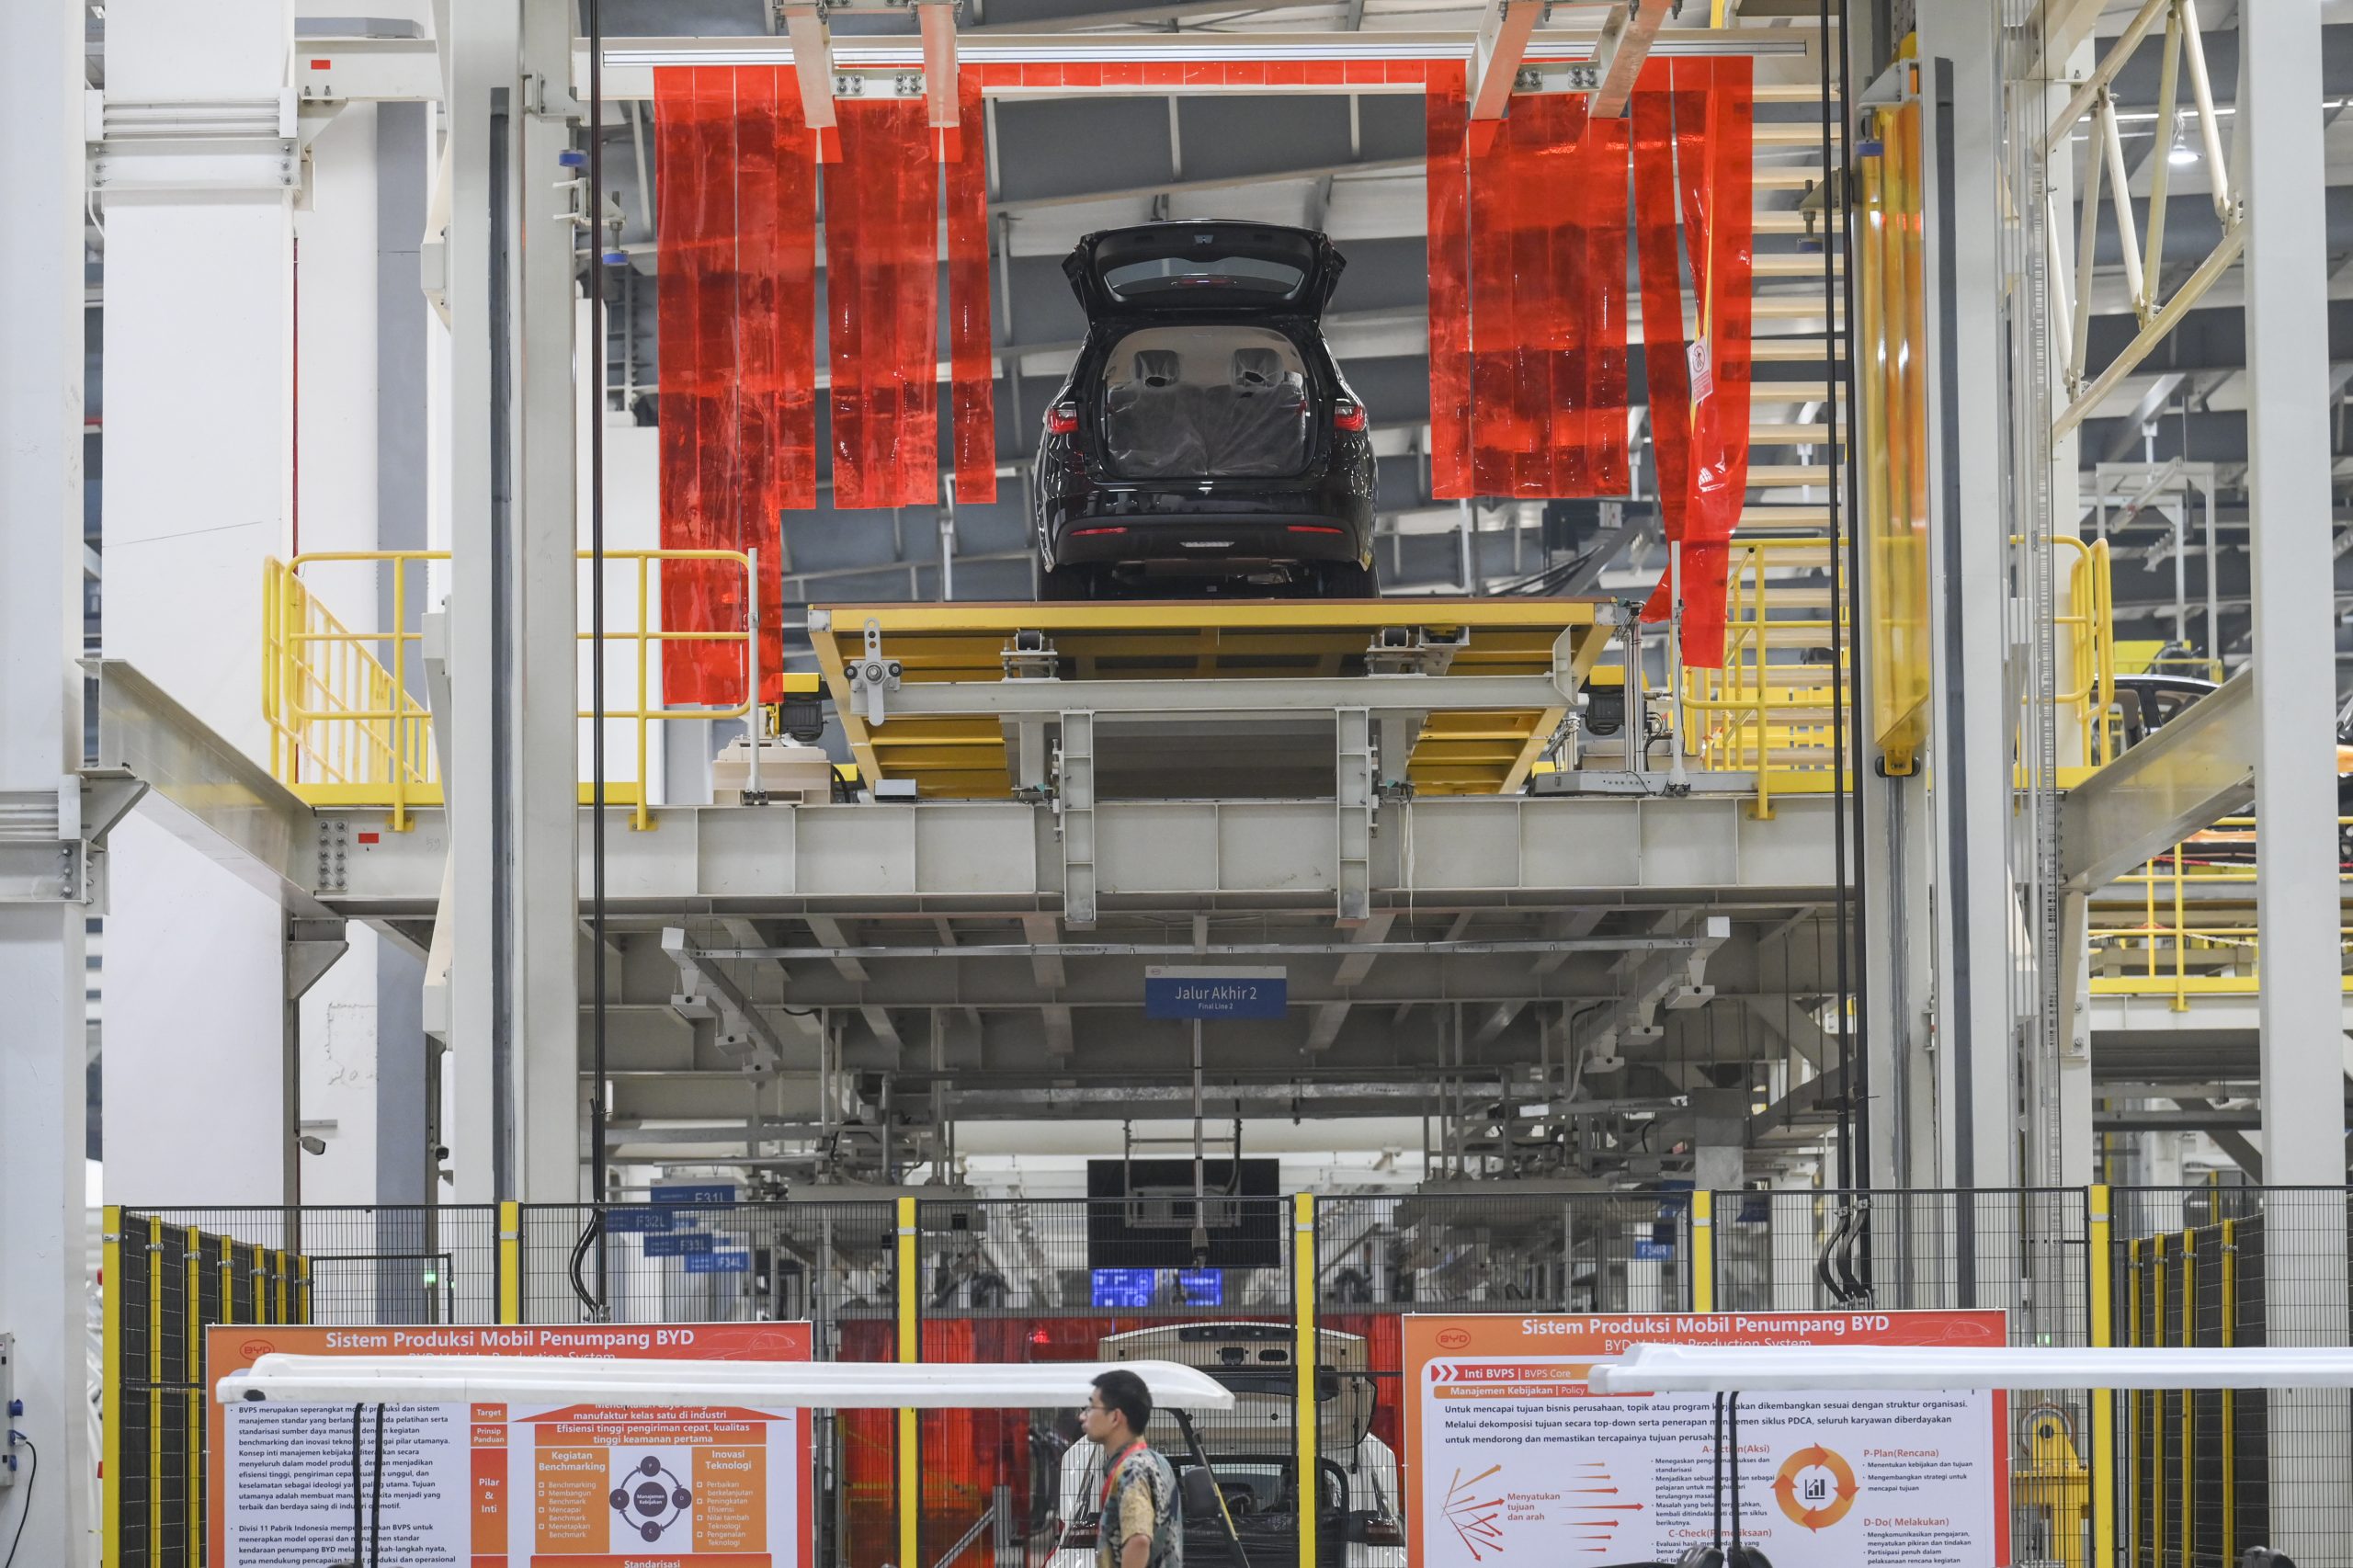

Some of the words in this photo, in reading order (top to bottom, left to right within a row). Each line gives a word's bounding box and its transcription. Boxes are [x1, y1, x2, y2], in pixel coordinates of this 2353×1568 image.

[1176, 986, 1210, 999] Jalur
[1212, 986, 1247, 999] Akhir
[1250, 987, 1256, 999] 2
[1522, 1320, 1583, 1335] Sistem
[1591, 1319, 1669, 1333] Produksi
[1677, 1317, 1729, 1333] Mobil
[1736, 1317, 1845, 1335] Penumpang
[1852, 1316, 1889, 1331] BYD
[326, 1332, 387, 1347] Sistem
[394, 1332, 473, 1347] Produksi
[482, 1331, 533, 1346] Mobil
[540, 1331, 650, 1349] Penumpang
[656, 1330, 694, 1345] BYD
[1440, 1335, 1466, 1343] BYD
[1605, 1340, 1631, 1352] BYD
[1465, 1368, 1483, 1379] Inti
[1486, 1369, 1514, 1378] BVPS
[1525, 1369, 1548, 1378] BVPS
[1551, 1369, 1571, 1378] Core
[1450, 1387, 1505, 1397] Manajemen
[1508, 1386, 1552, 1396] Kebijakan
[1562, 1387, 1585, 1395] Policy
[1473, 1404, 1514, 1415] mencapai
[1517, 1404, 1543, 1414] tujuan
[1574, 1404, 1624, 1414] perusahaan,
[1627, 1403, 1648, 1414] topik
[1673, 1404, 1710, 1413] program
[1758, 1402, 1820, 1411] dikembangkan
[1824, 1401, 1849, 1409] sesuai
[1852, 1401, 1883, 1411] dengan
[1923, 1400, 1967, 1410] organisasi.
[477, 1409, 501, 1418] Target
[574, 1412, 628, 1420] manufaktur
[679, 1411, 688, 1419] di
[691, 1411, 726, 1419] industri
[1445, 1420, 1476, 1428] Melalui
[1479, 1420, 1532, 1429] dekomposisi
[1536, 1420, 1562, 1429] tujuan
[1594, 1419, 1635, 1427] top-down
[1663, 1420, 1707, 1429] penerapan
[1789, 1417, 1814, 1426] PDCA,
[1817, 1416, 1848, 1425] seluruh
[1851, 1416, 1892, 1426] karyawan
[1894, 1415, 1951, 1425] diberdayakan
[477, 1427, 501, 1436] Prinsip
[557, 1425, 594, 1433] Efisiensi
[597, 1425, 624, 1434] tinggi
[628, 1425, 680, 1434] pengiriman
[683, 1424, 710, 1433] cepat,
[714, 1423, 749, 1431] kualitas
[594, 1436, 620, 1445] tinggi
[1473, 1436, 1522, 1445] mendorong
[1597, 1434, 1646, 1443] tercapainya
[551, 1451, 592, 1461] Kegiatan
[712, 1450, 745, 1459] Inovasi
[1864, 1449, 1939, 1458] P-Plan(Rencana)
[539, 1462, 605, 1472] Benchmarking
[706, 1460, 751, 1471] Teknologi
[285, 1482, 311, 1490] sebagai
[479, 1478, 499, 1486] Pilar
[1507, 1493, 1560, 1502] Menyatukan
[482, 1505, 497, 1513] Inti
[1864, 1518, 1892, 1528] D-Do(
[1895, 1517, 1949, 1527] Melakukan)
[625, 1560, 680, 1568] Standarisasi
